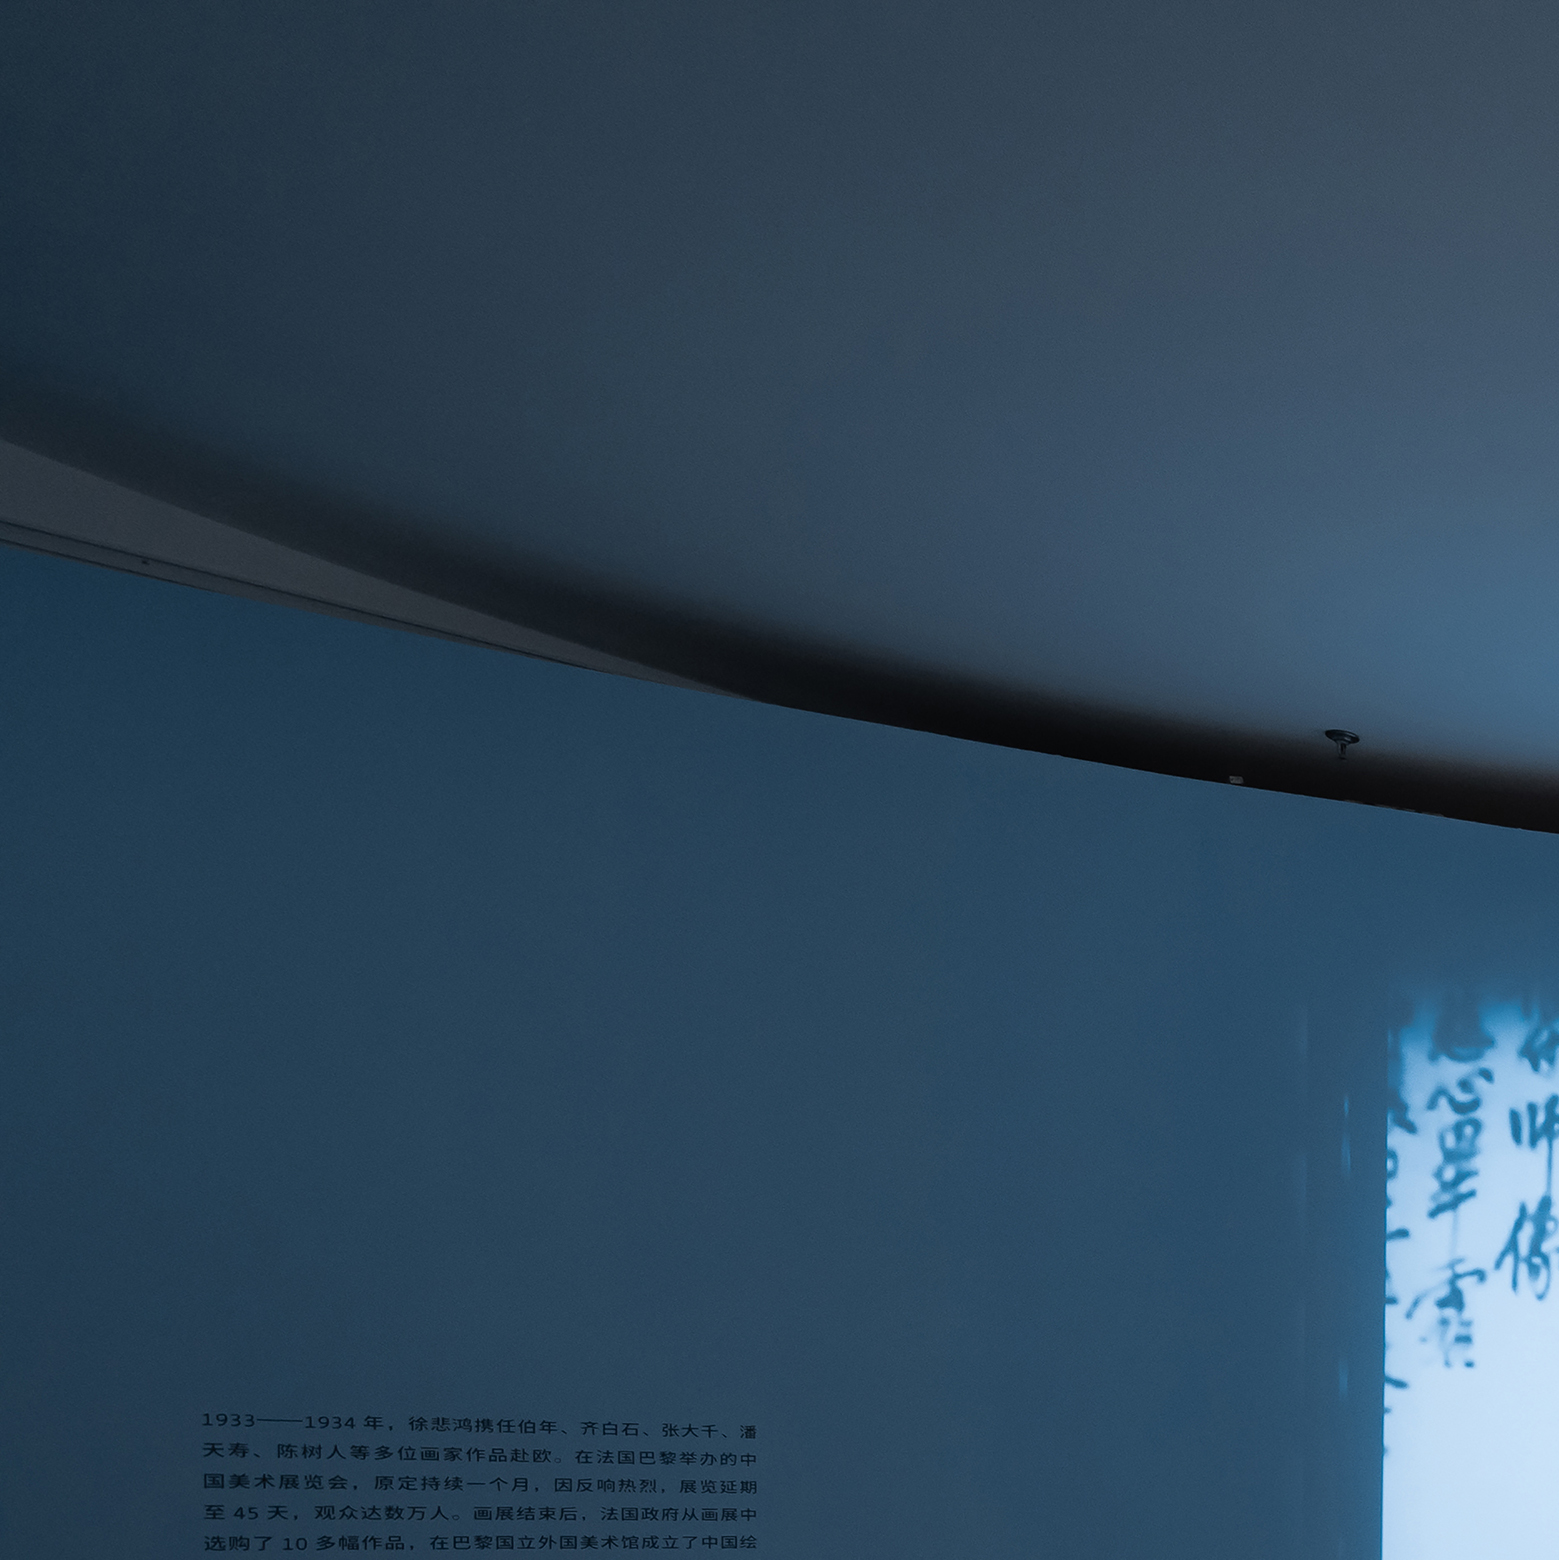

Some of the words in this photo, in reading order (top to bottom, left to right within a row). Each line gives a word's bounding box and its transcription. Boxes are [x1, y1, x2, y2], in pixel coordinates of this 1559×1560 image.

[202, 1442, 757, 1467] 天寿、陈树人等多位画家作品赴欧。在法国巴黎举办的中
[203, 1473, 757, 1495] 国美术展览会，原定持续一个月，因反响热烈，展览延期
[234, 1506, 259, 1520] 45
[267, 1504, 757, 1522] 天，观众达数万人。画展结束后，法国政府从画展中
[204, 1535, 272, 1552] 选购了
[283, 1537, 308, 1551] 10
[316, 1534, 757, 1551] 多幅作品，在巴黎国立外国美术馆成立了中国绘
